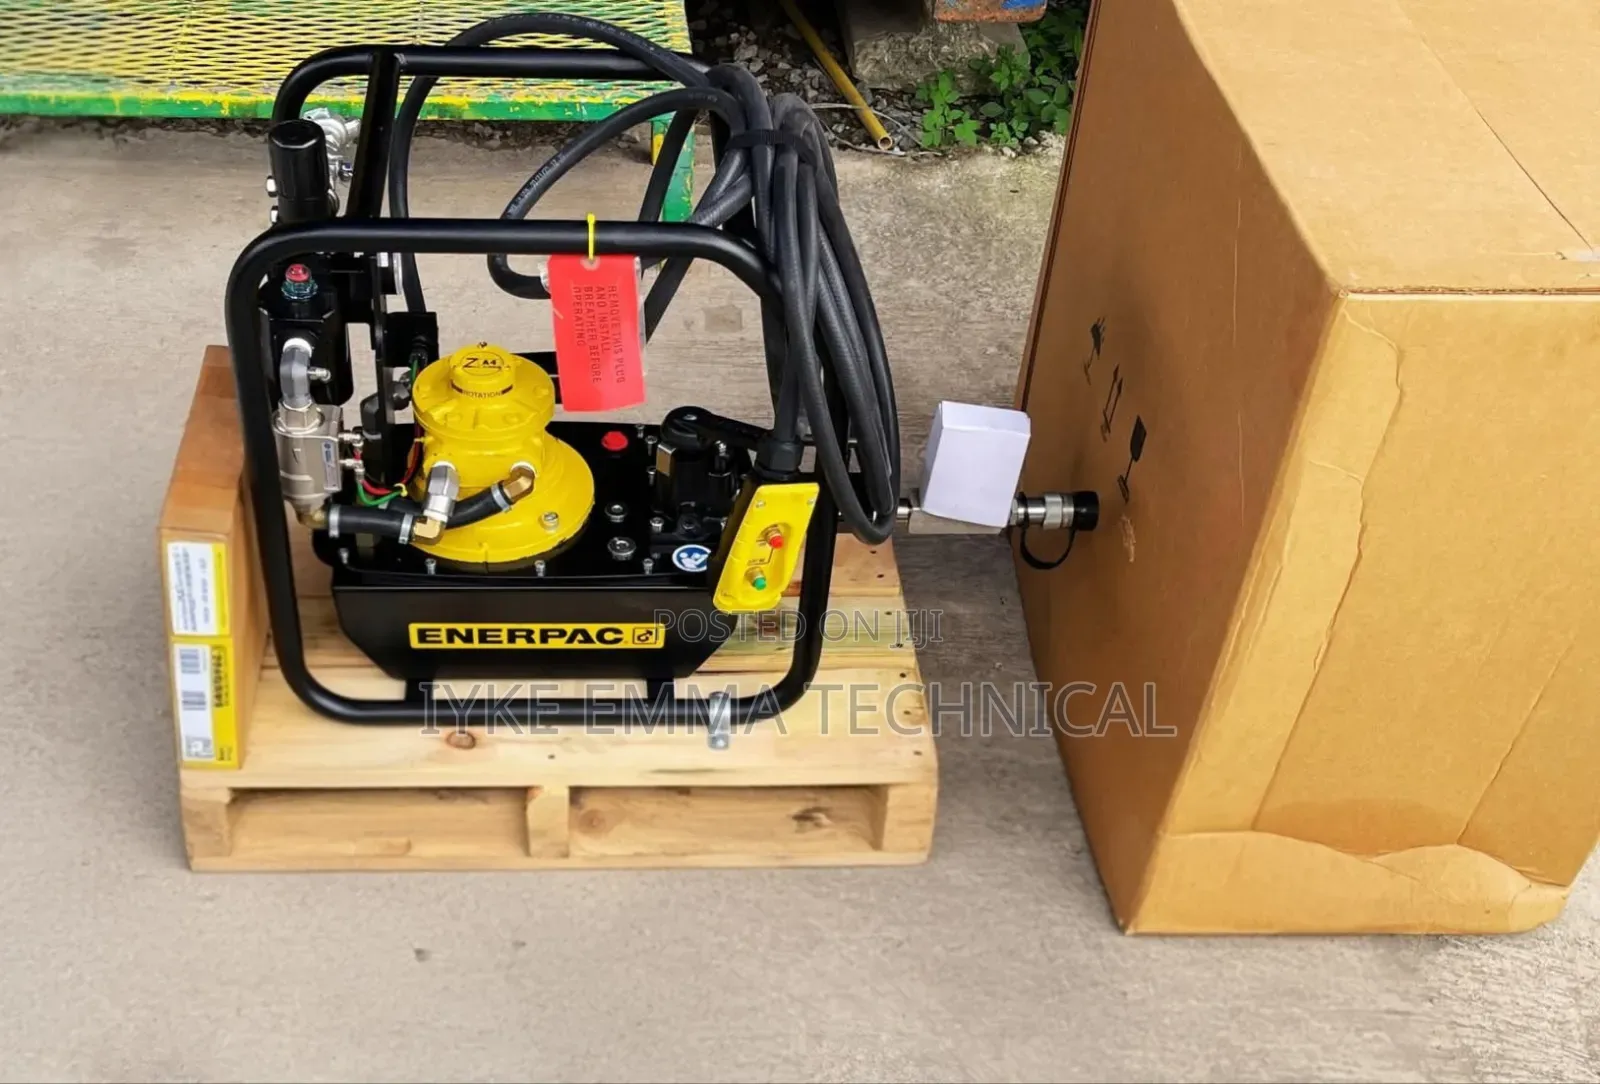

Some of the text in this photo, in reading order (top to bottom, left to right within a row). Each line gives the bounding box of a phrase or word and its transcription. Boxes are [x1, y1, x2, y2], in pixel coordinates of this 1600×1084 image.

[572, 286, 586, 347] OPERATING
[583, 285, 602, 384] BREATHER BEFORE
[595, 285, 610, 354] AND INSTALL
[607, 285, 626, 384] REMOVE THIS PLUG
[416, 627, 625, 645] ENERPAC
